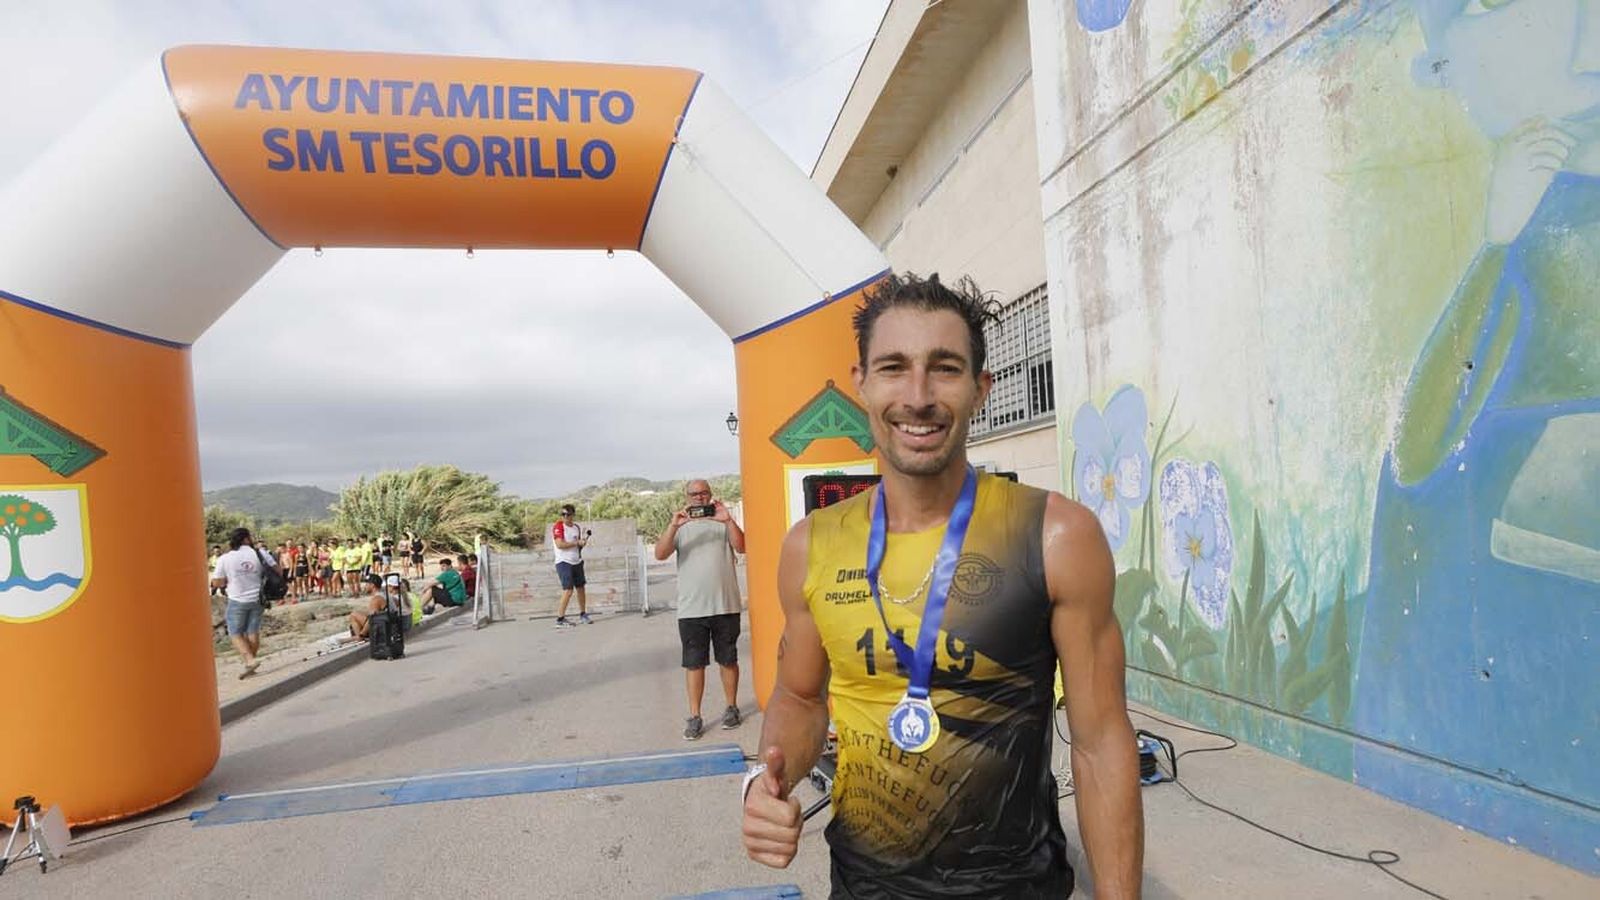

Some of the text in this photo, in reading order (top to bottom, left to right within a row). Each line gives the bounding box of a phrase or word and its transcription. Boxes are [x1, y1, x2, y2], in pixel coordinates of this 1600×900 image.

[234, 73, 635, 125] AYUNTAMIENTO
[262, 127, 617, 180] SM TESORILLO
